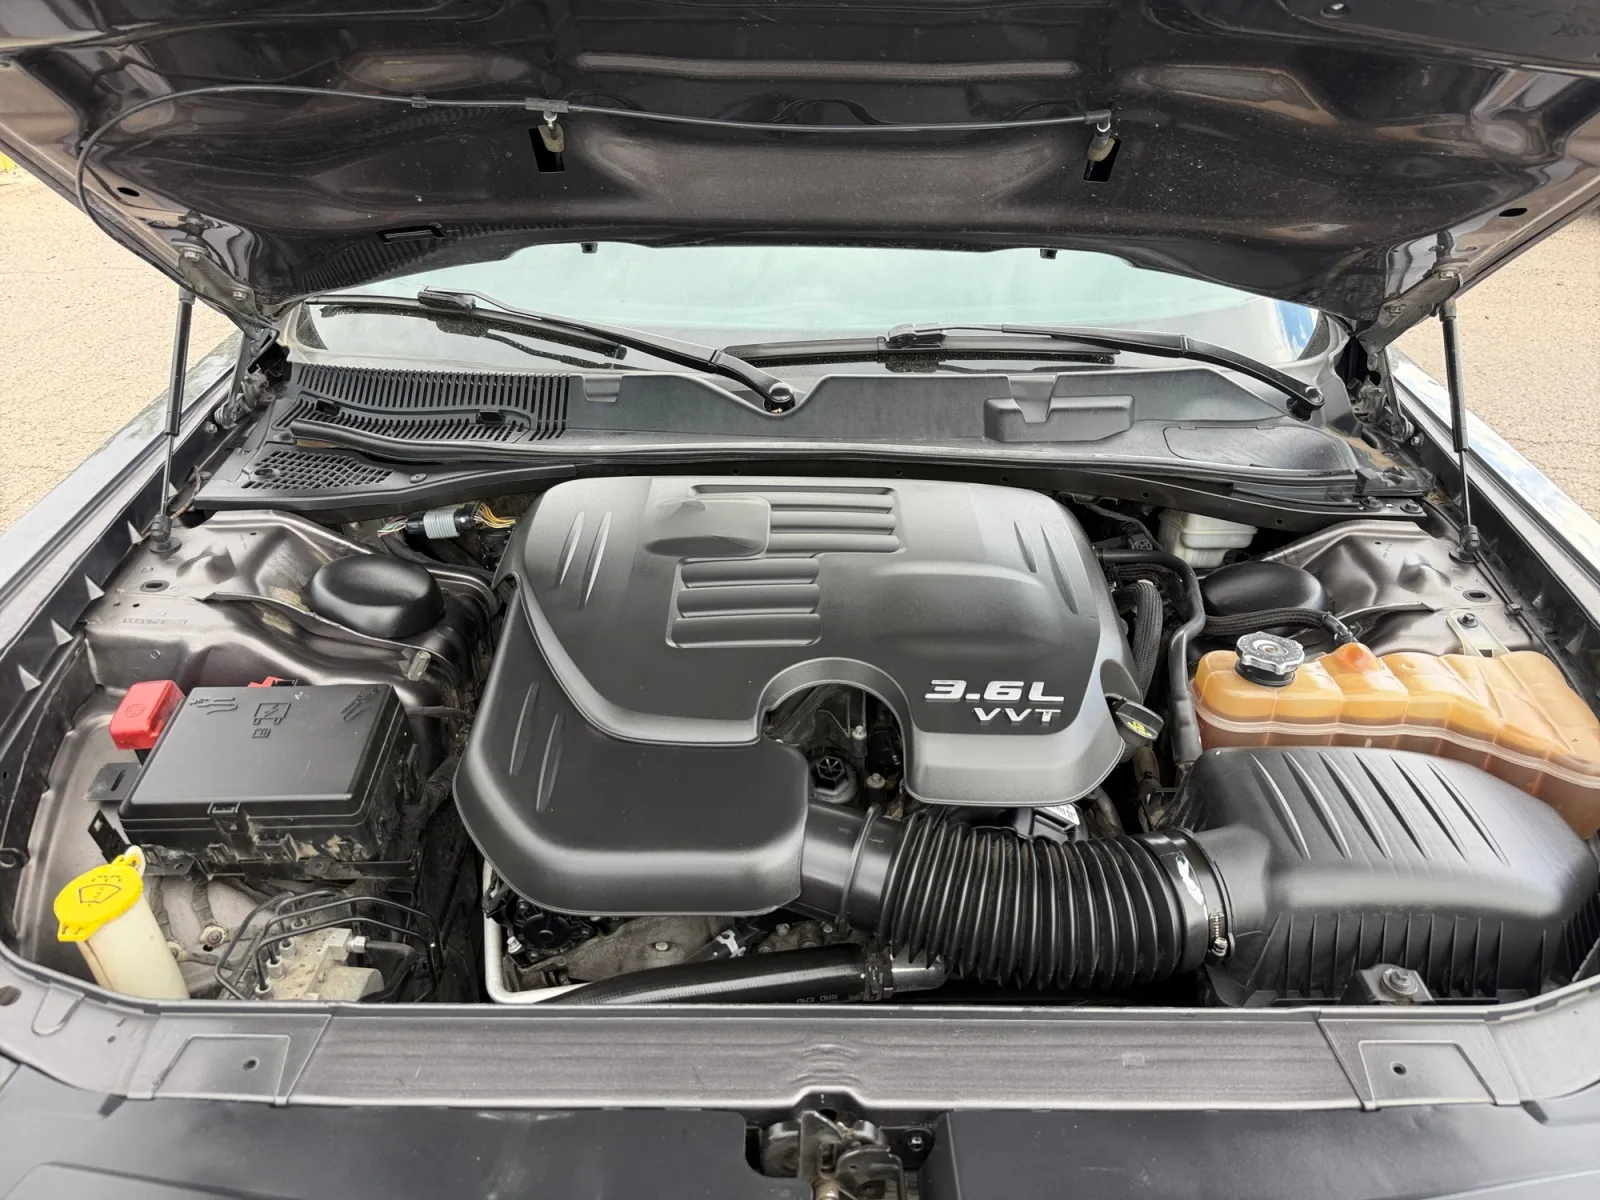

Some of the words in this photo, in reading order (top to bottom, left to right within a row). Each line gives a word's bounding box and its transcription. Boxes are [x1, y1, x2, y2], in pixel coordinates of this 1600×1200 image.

[924, 679, 1065, 703] 3.6L
[972, 706, 1063, 724] VVT
[819, 993, 838, 1002] RAD
